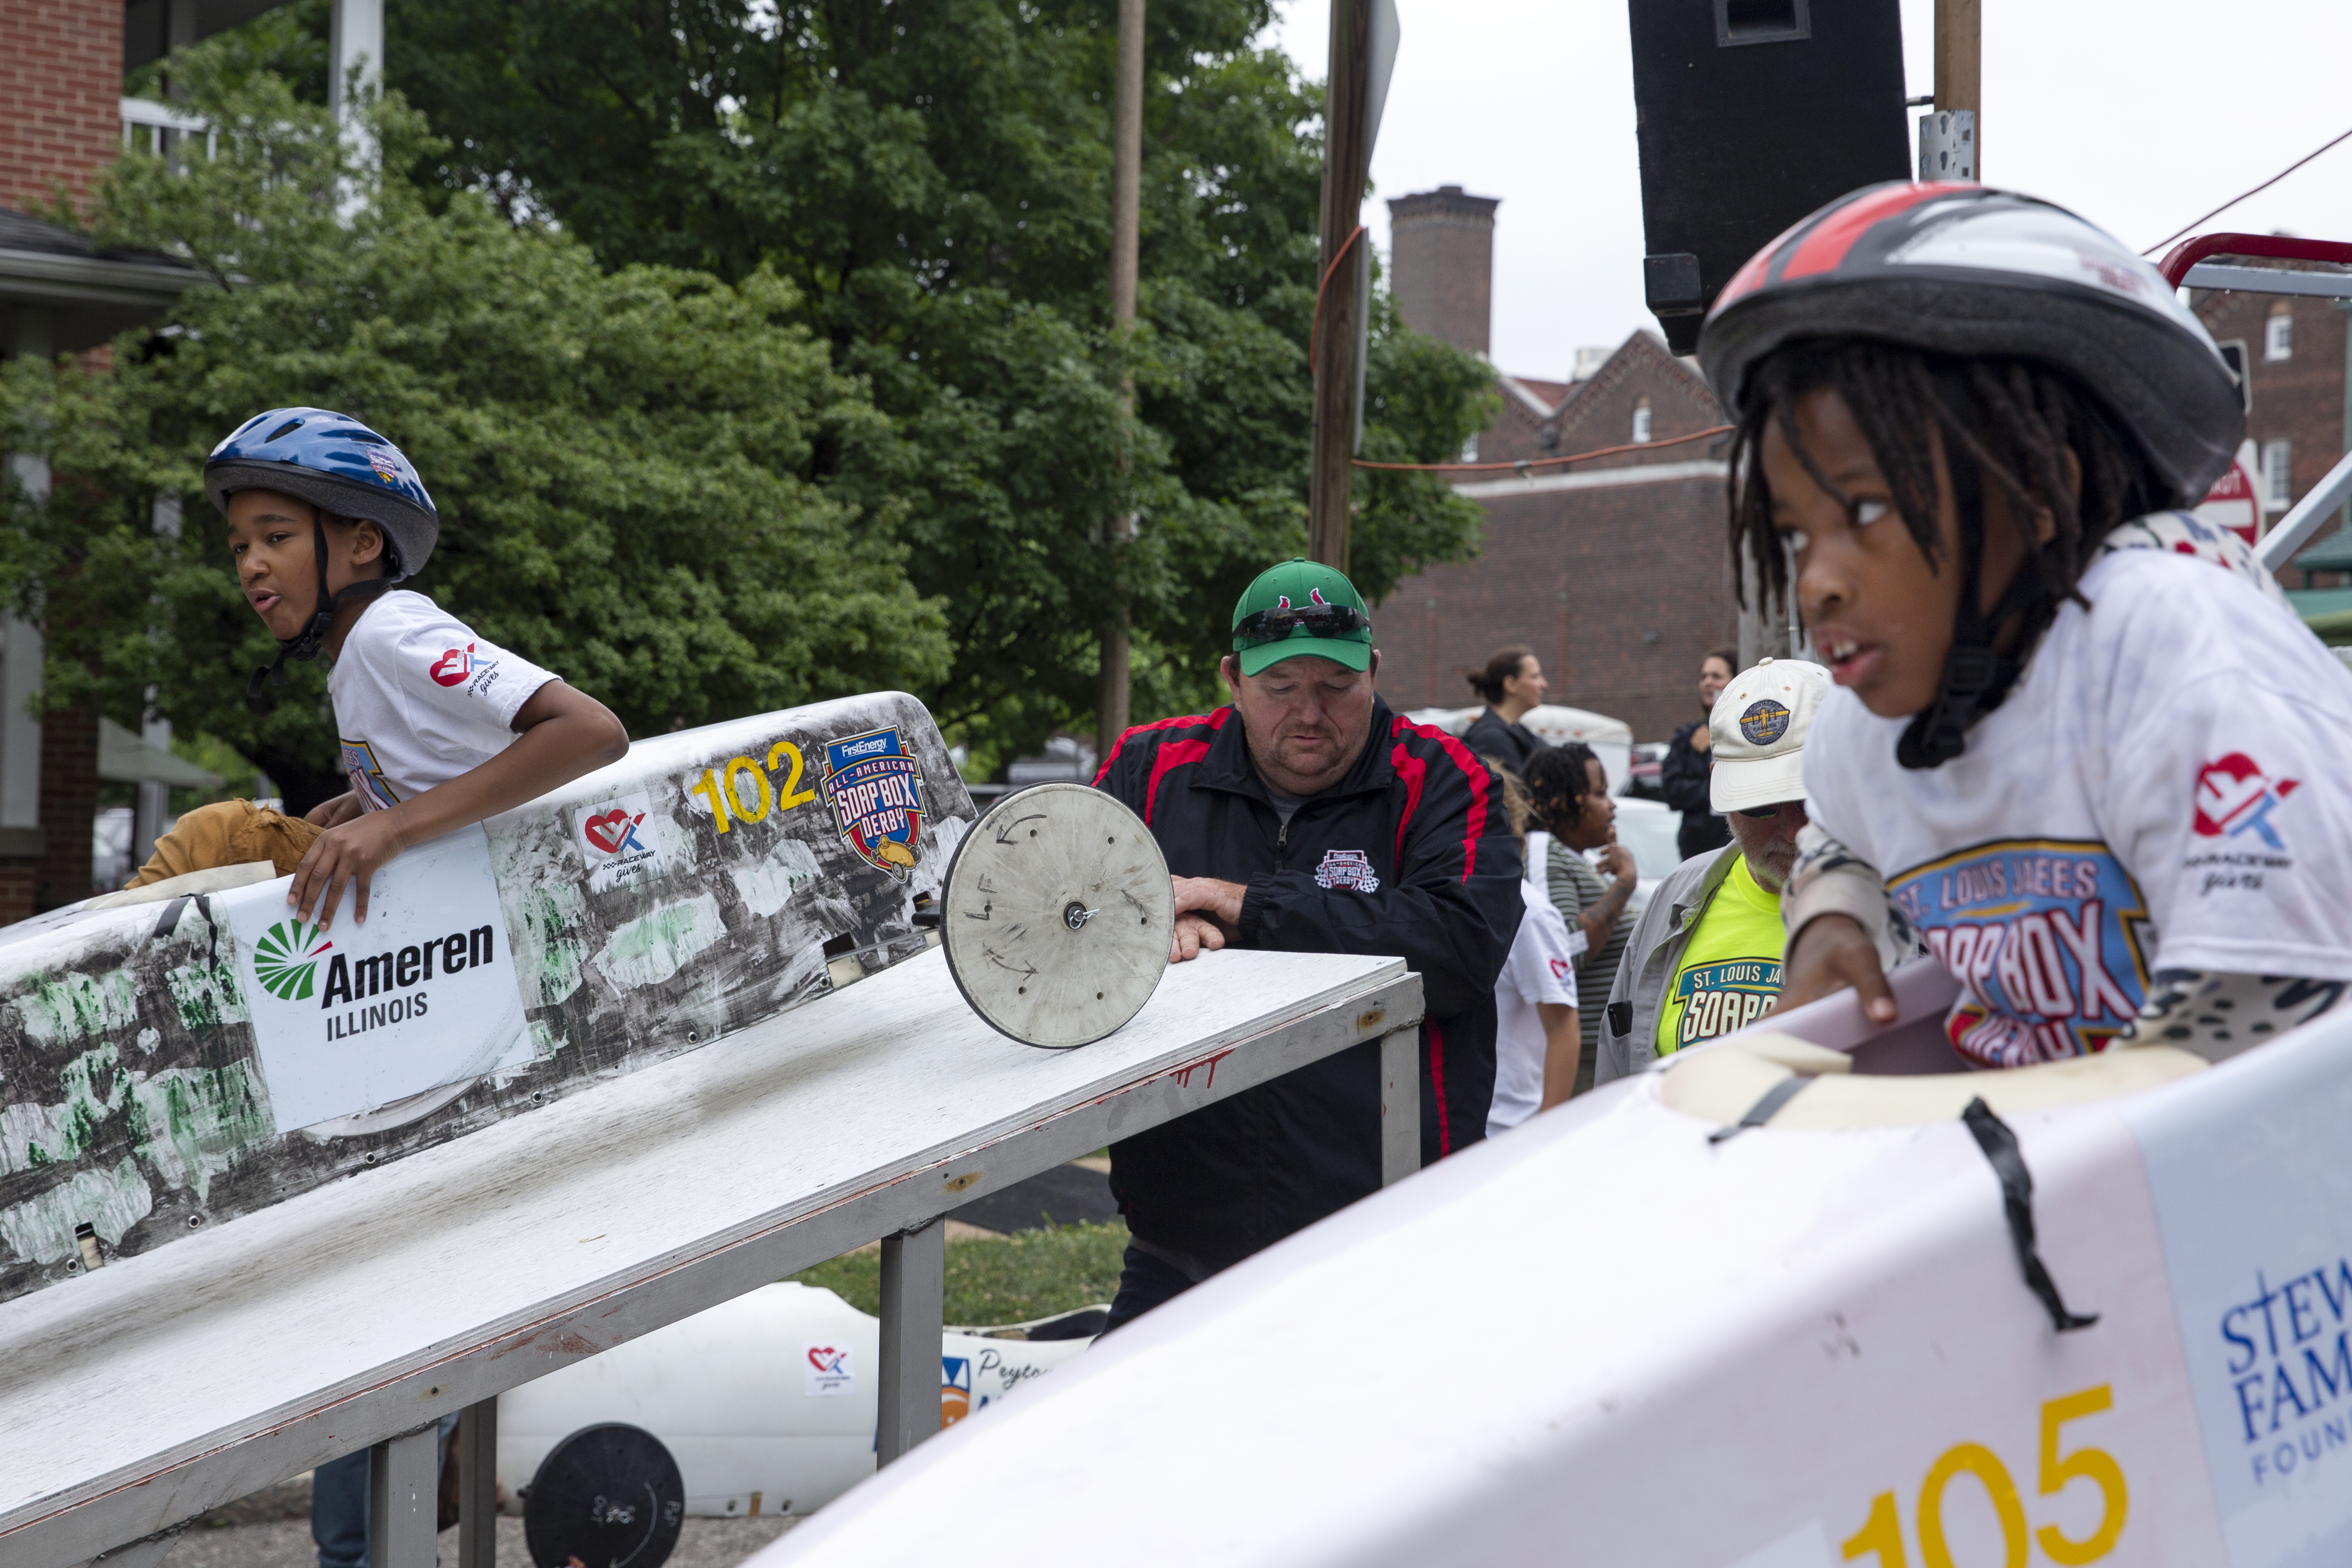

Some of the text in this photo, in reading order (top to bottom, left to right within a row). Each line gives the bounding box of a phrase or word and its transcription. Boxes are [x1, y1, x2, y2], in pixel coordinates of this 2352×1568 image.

[473, 660, 499, 687] RACEWAY
[480, 671, 499, 696] gives
[842, 738, 887, 757] FirstEnergy
[692, 741, 816, 834] 102
[828, 760, 915, 794] ALL-AMERICAN
[836, 772, 919, 827] SOAP BOX
[861, 807, 905, 839] DERBY
[615, 863, 643, 883] gives
[617, 850, 656, 866] RACEWAY
[321, 924, 494, 1010] Ameren
[1693, 964, 1786, 989] ST. LOUIS JA
[327, 992, 428, 1042] ILLINOIS
[2221, 1257, 2352, 1376] STEW
[977, 1346, 1054, 1391] Peyto
[2233, 1328, 2352, 1445] FAM
[2251, 1405, 2352, 1488] FOUN
[1841, 1382, 2129, 1568] 105
